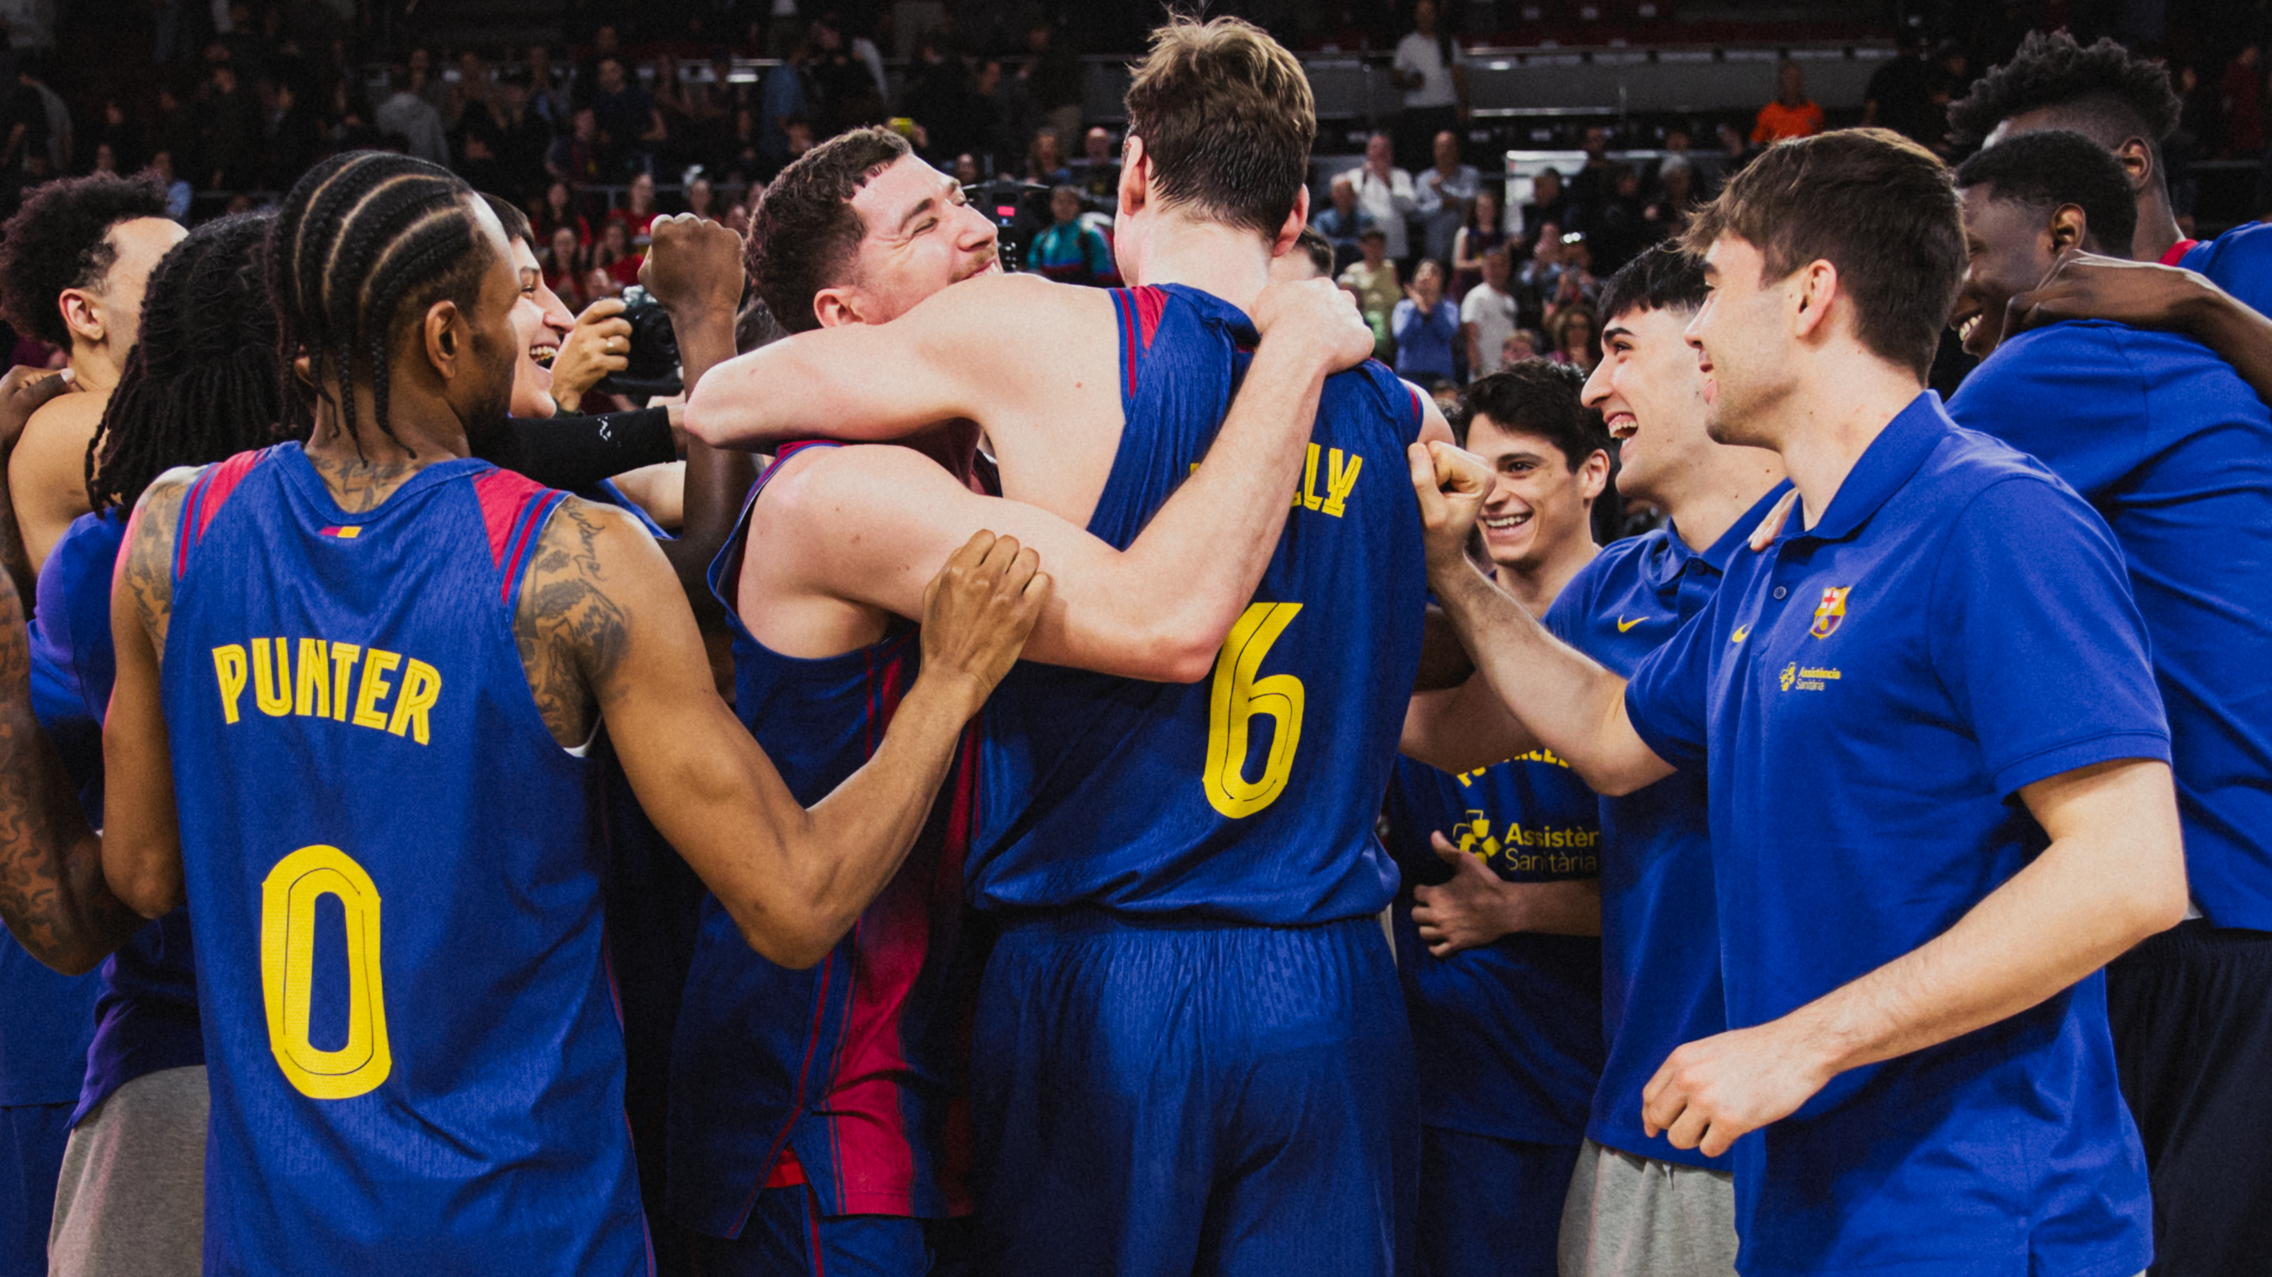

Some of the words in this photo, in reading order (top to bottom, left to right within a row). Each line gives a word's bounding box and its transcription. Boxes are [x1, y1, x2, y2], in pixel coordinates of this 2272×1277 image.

[212, 637, 442, 746] PUNTER
[1203, 602, 1305, 818] 6
[261, 844, 392, 1099] 0
